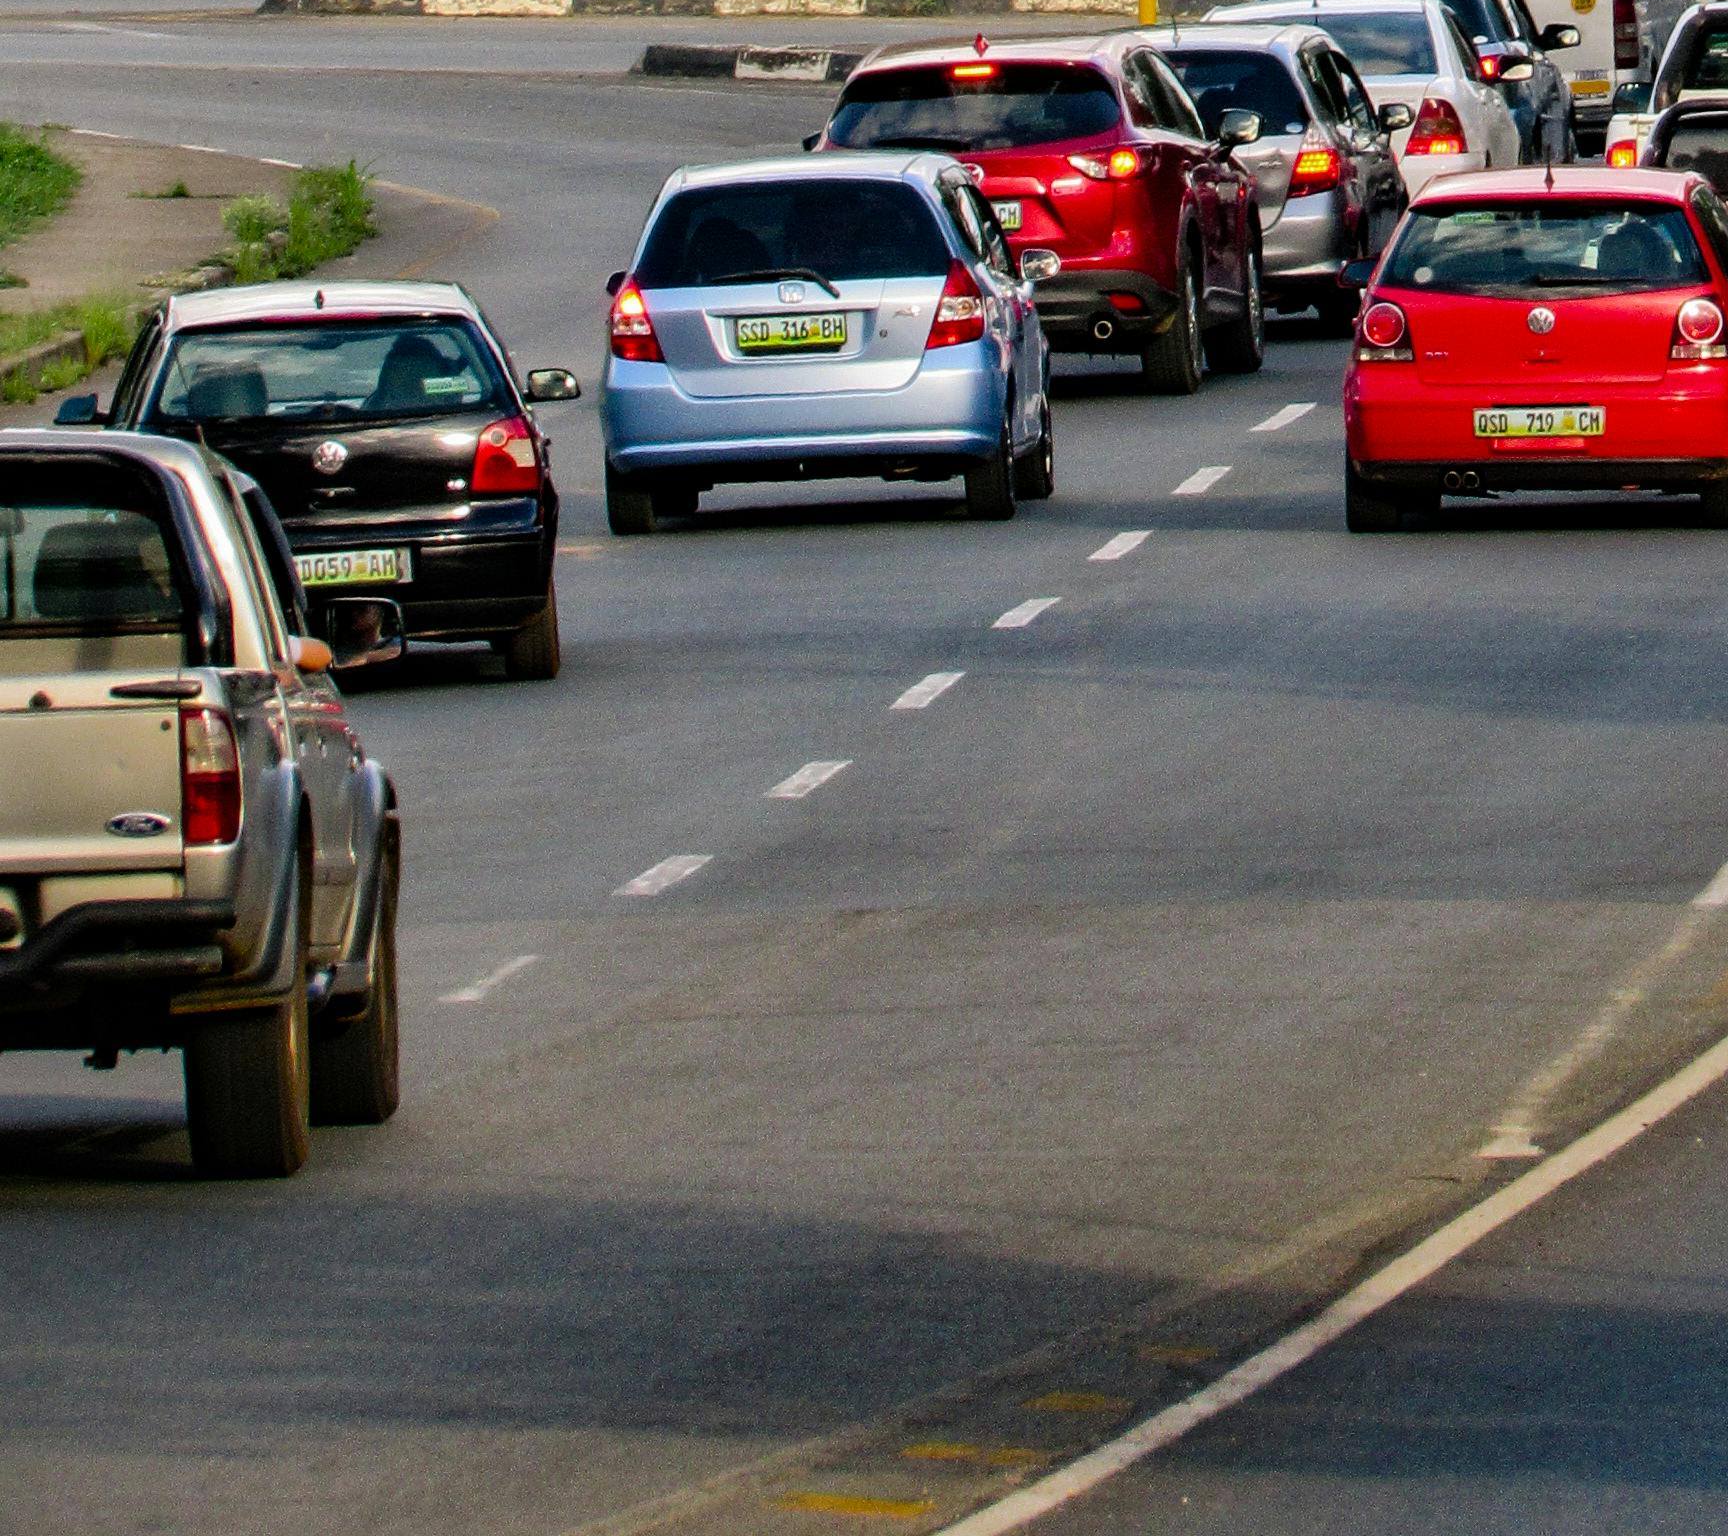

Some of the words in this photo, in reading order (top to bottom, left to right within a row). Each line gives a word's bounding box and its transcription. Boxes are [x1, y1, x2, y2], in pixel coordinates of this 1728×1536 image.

[740, 321, 770, 343] SSD
[781, 319, 810, 340] 316
[821, 317, 843, 339] BH
[1478, 413, 1508, 434] QSD
[1527, 412, 1554, 433] 719
[1578, 411, 1600, 432] CM
[298, 556, 353, 582] D059
